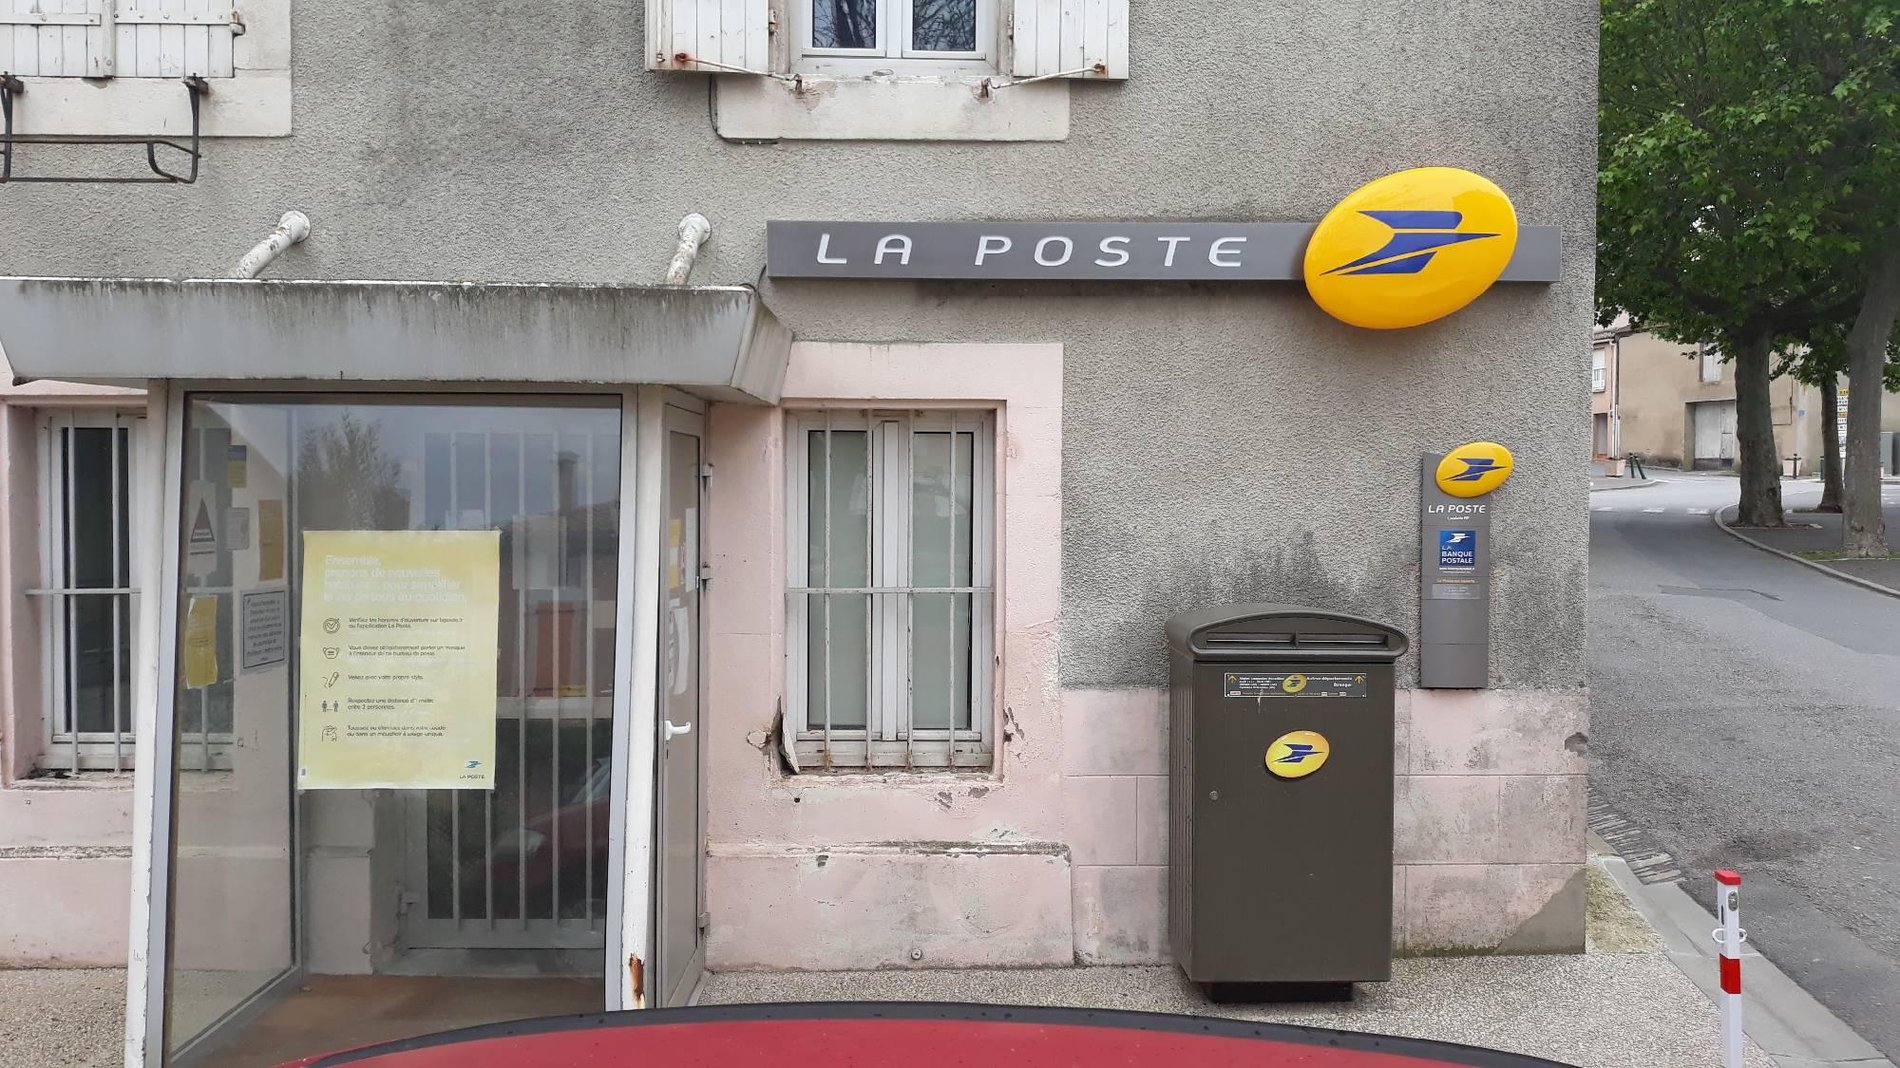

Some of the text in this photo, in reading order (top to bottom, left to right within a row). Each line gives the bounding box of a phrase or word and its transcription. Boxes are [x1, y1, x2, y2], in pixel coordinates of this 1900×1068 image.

[815, 232, 1248, 268] LA POSTE
[1428, 504, 1486, 514] LA POSTE
